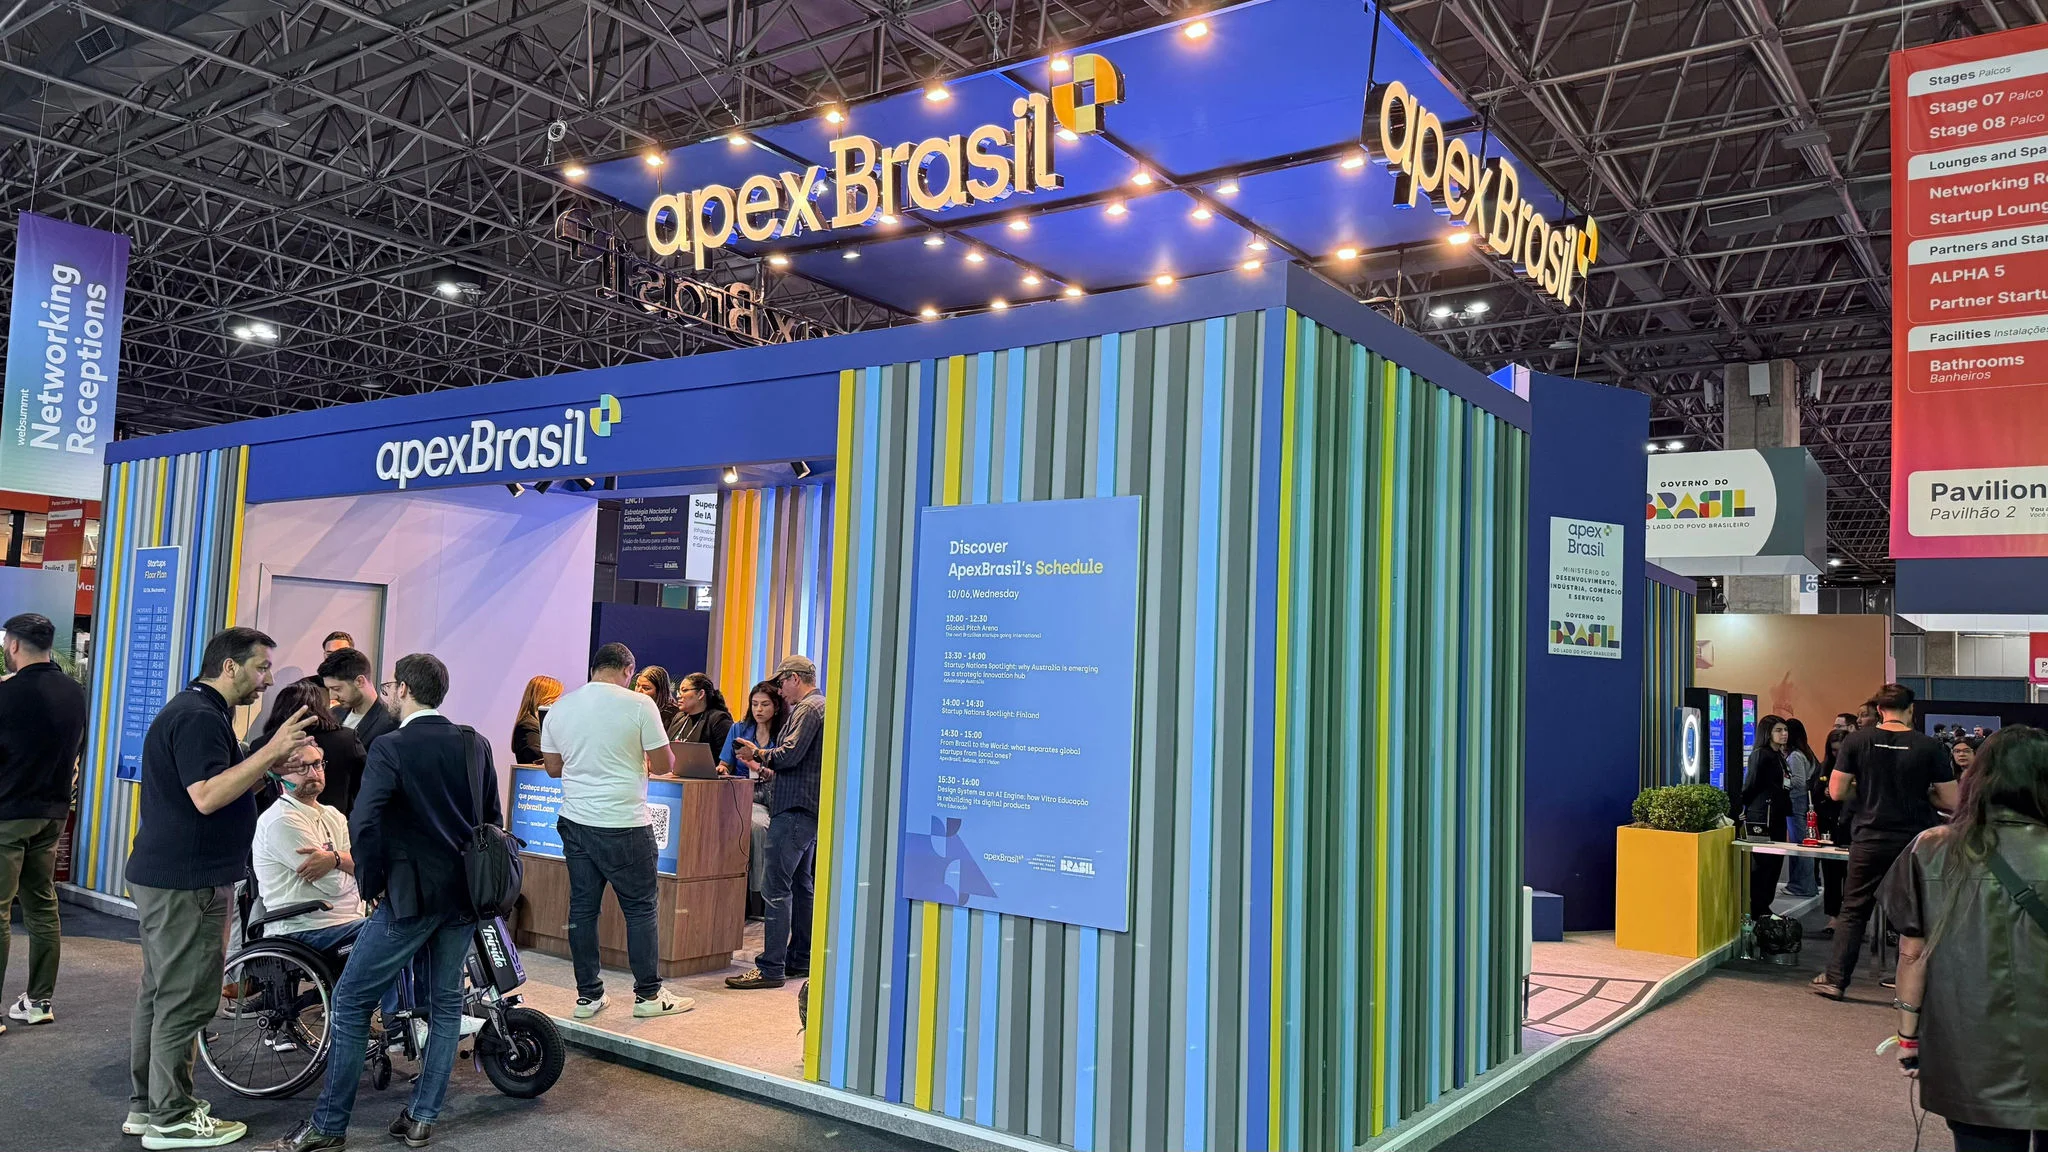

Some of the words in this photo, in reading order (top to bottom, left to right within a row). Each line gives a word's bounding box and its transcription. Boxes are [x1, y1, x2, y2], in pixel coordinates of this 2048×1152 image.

[1929, 70, 1975, 86] Stages
[1978, 65, 2011, 78] Palcos
[1929, 98, 1978, 115] Stage
[1982, 92, 2004, 106] 07
[2008, 89, 2043, 102] Palco
[1929, 122, 1978, 139] Stage
[1982, 116, 2006, 130] 08
[2010, 113, 2045, 126] Palco
[1930, 153, 1987, 171] Lounges
[1990, 147, 2016, 161] and
[647, 92, 1060, 270] apexBrasil
[1930, 175, 2029, 199] Networking
[1380, 80, 1577, 307] apexBrasil
[1930, 207, 1993, 226] Startup
[1930, 239, 1988, 256] Partners
[1991, 233, 2017, 248] and
[1930, 267, 1989, 284] ALPHA
[1994, 265, 2005, 277] 5
[1930, 295, 1993, 311] Partner
[1930, 329, 1991, 343] Facilities
[30, 264, 81, 450] Networking
[1930, 355, 2024, 372] Bathrooms
[66, 283, 108, 455] Receptions
[1930, 371, 1991, 383] Banheiros
[16, 388, 29, 446] websummit
[376, 408, 588, 489] apexBrasil
[1661, 480, 1709, 488] GOVERNO
[1932, 479, 2047, 502] Pavilion
[1930, 506, 1999, 520] Pavilhão
[2006, 506, 2016, 518] 2
[1568, 523, 1602, 539] apex
[950, 541, 1008, 555] Discover
[1568, 538, 1604, 557] Brasil
[948, 560, 1032, 580] ApexBrasil's
[1036, 558, 1103, 576] Schedule
[1556, 575, 1617, 586] DESENVOLVIMENTO,
[1551, 583, 1587, 592] INDÚSTRIA,
[1589, 586, 1622, 595] COMÉRCIO
[1574, 594, 1604, 603] SERVIÇOS
[970, 615, 988, 623] 12:30
[1566, 612, 1594, 620] GOVERNO
[1550, 620, 1620, 649] BRASIL
[968, 652, 986, 660] 14:00
[944, 662, 965, 670] Startup
[988, 663, 1016, 672] Spotlight:
[1068, 666, 1098, 674] emerging
[956, 671, 982, 679] strategic
[966, 700, 984, 708] 14:30
[942, 708, 963, 716] Startup
[964, 708, 985, 716] Nations
[986, 710, 1015, 719] Spotlight:
[1016, 711, 1040, 719] Finland
[941, 729, 958, 737] 14:30
[964, 730, 982, 738] 15:00
[940, 748, 963, 756] startups
[978, 750, 993, 758] local
[995, 752, 1012, 760] ones?
[1028, 745, 1058, 754] separates
[1059, 747, 1081, 756] global
[938, 776, 956, 784] 15:30
[962, 777, 980, 786] 16:00
[938, 786, 956, 794] Design
[957, 787, 978, 796] System
[1058, 797, 1089, 806] Educação
[943, 796, 972, 805] rebuilding
[982, 799, 1002, 808] digital
[1003, 801, 1030, 810] products
[984, 852, 1019, 864] apexBrasil
[1060, 859, 1095, 875] BRASIL
